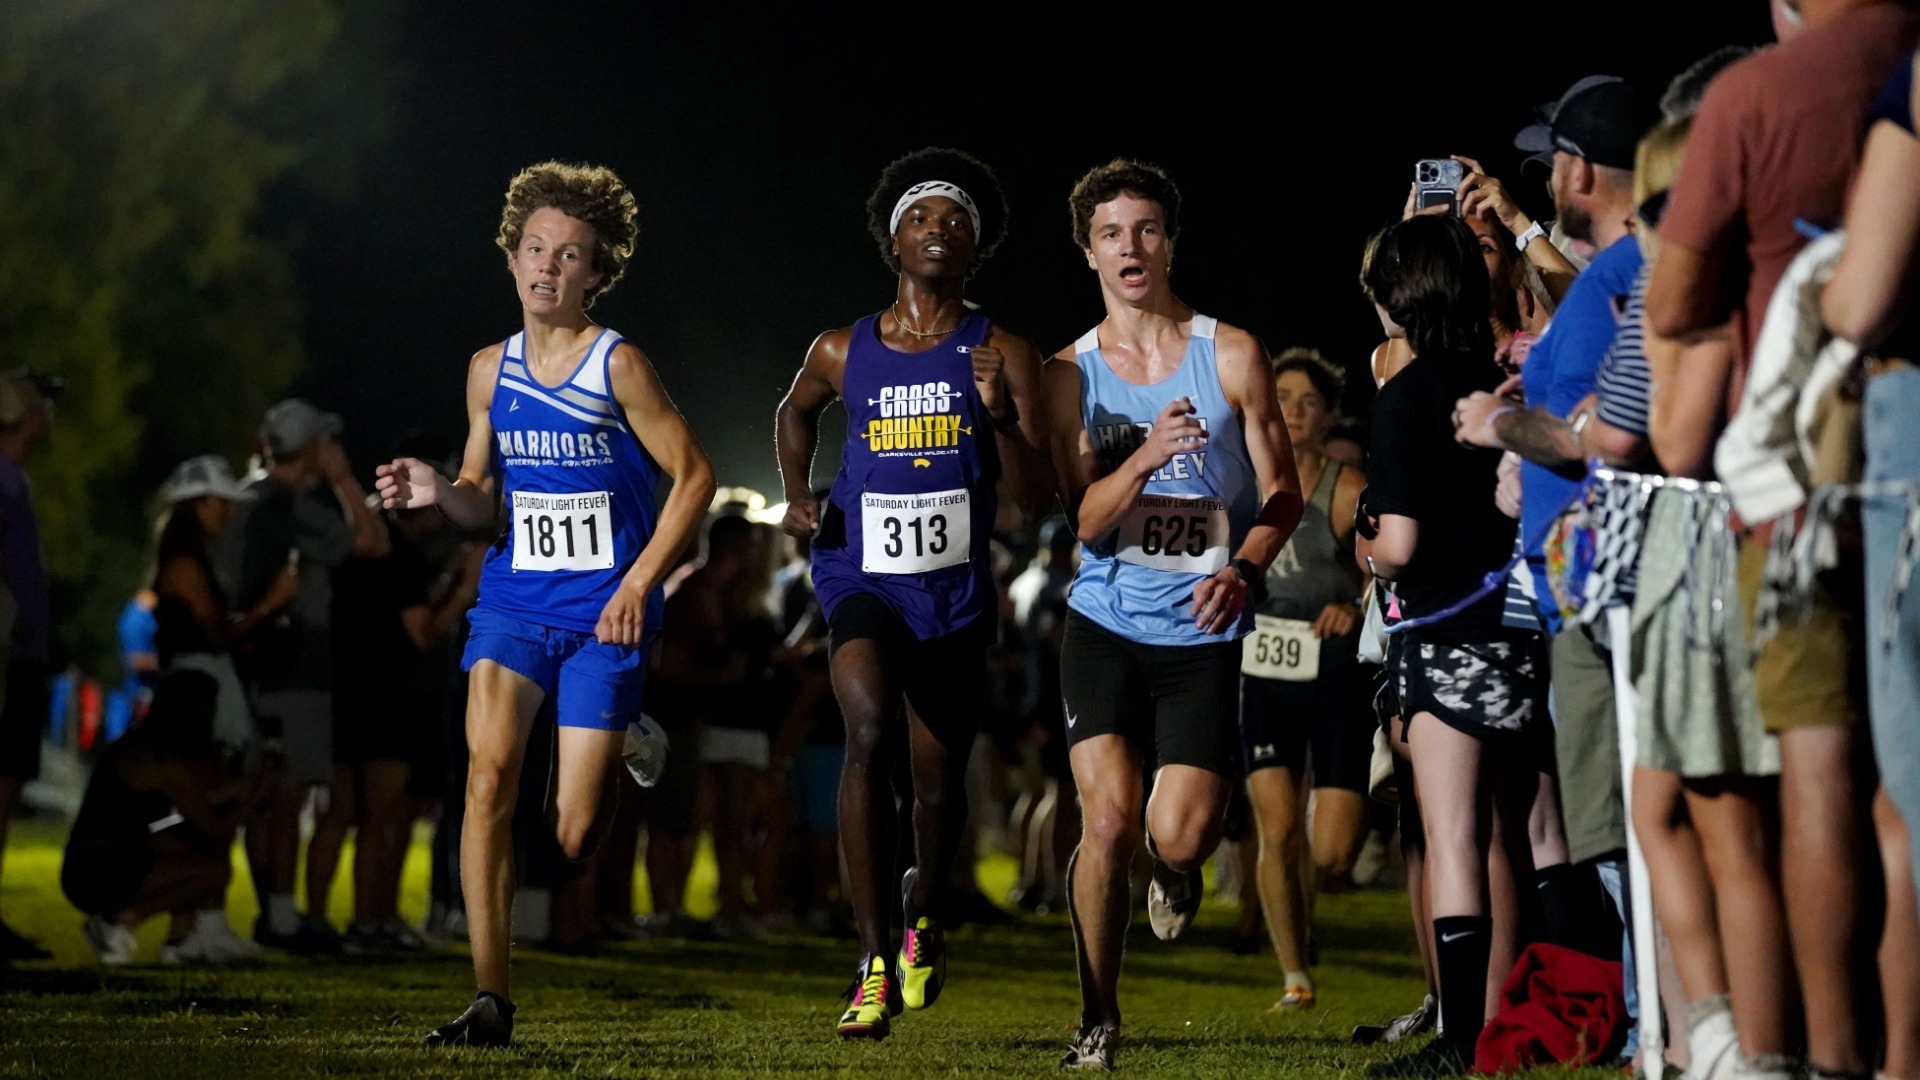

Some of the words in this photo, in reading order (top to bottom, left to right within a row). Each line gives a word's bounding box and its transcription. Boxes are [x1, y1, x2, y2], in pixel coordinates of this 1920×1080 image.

[880, 381, 951, 418] CROSS
[497, 429, 611, 458] WARRIORS
[868, 415, 961, 452] COUNTRY
[1096, 417, 1208, 450] HAR
[515, 496, 549, 509] SATURDAY
[551, 498, 575, 510] LIGHT
[578, 496, 608, 509] FEVER
[865, 498, 908, 509] SATURDAY
[911, 497, 937, 509] LIGHT
[939, 494, 966, 506] FEVER
[1136, 498, 1172, 508] TURDAY
[1174, 499, 1199, 509] LIGHT
[1202, 501, 1225, 510] FEVE
[523, 513, 600, 558] 1811
[883, 514, 948, 558] 313
[1142, 515, 1208, 557] 625
[1256, 633, 1301, 668] 539
